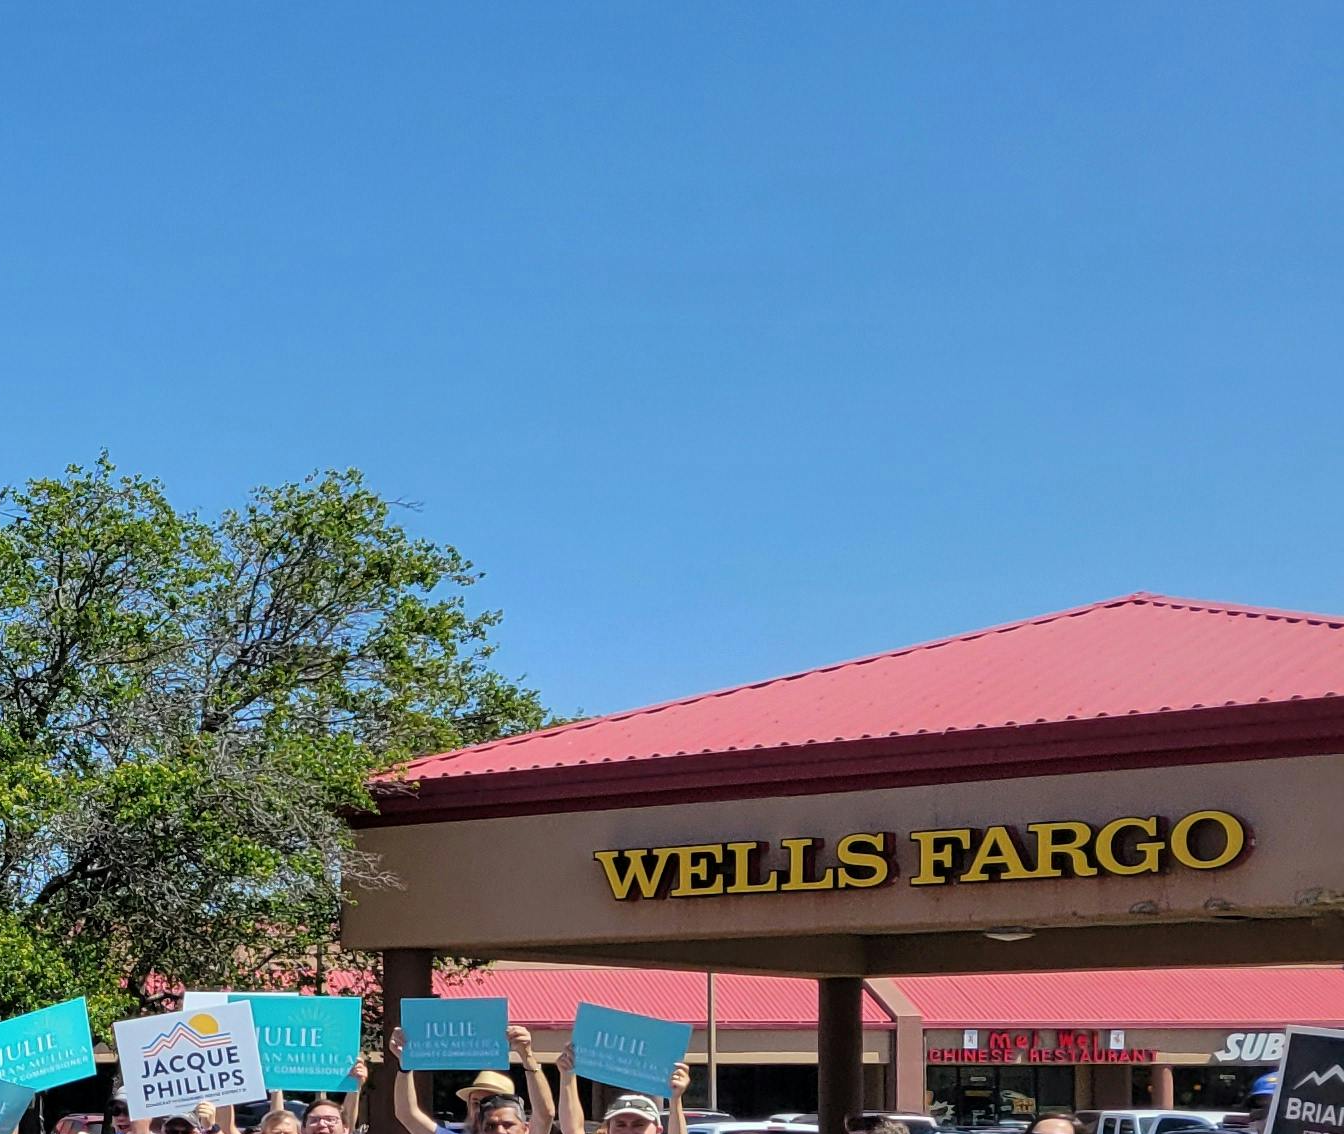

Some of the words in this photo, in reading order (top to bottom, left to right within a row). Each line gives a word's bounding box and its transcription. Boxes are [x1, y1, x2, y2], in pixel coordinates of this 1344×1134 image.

[593, 832, 889, 901] WELLS
[911, 810, 1248, 885] FARGO
[426, 1022, 476, 1039] JULIE
[595, 1031, 647, 1056] JULIE
[927, 1049, 1016, 1063] CHINESE
[1028, 1049, 1159, 1063] RESTAURANT
[1214, 1033, 1286, 1062] SUB
[141, 1046, 241, 1079] JACQUE
[143, 1069, 245, 1100] PHILLIPS
